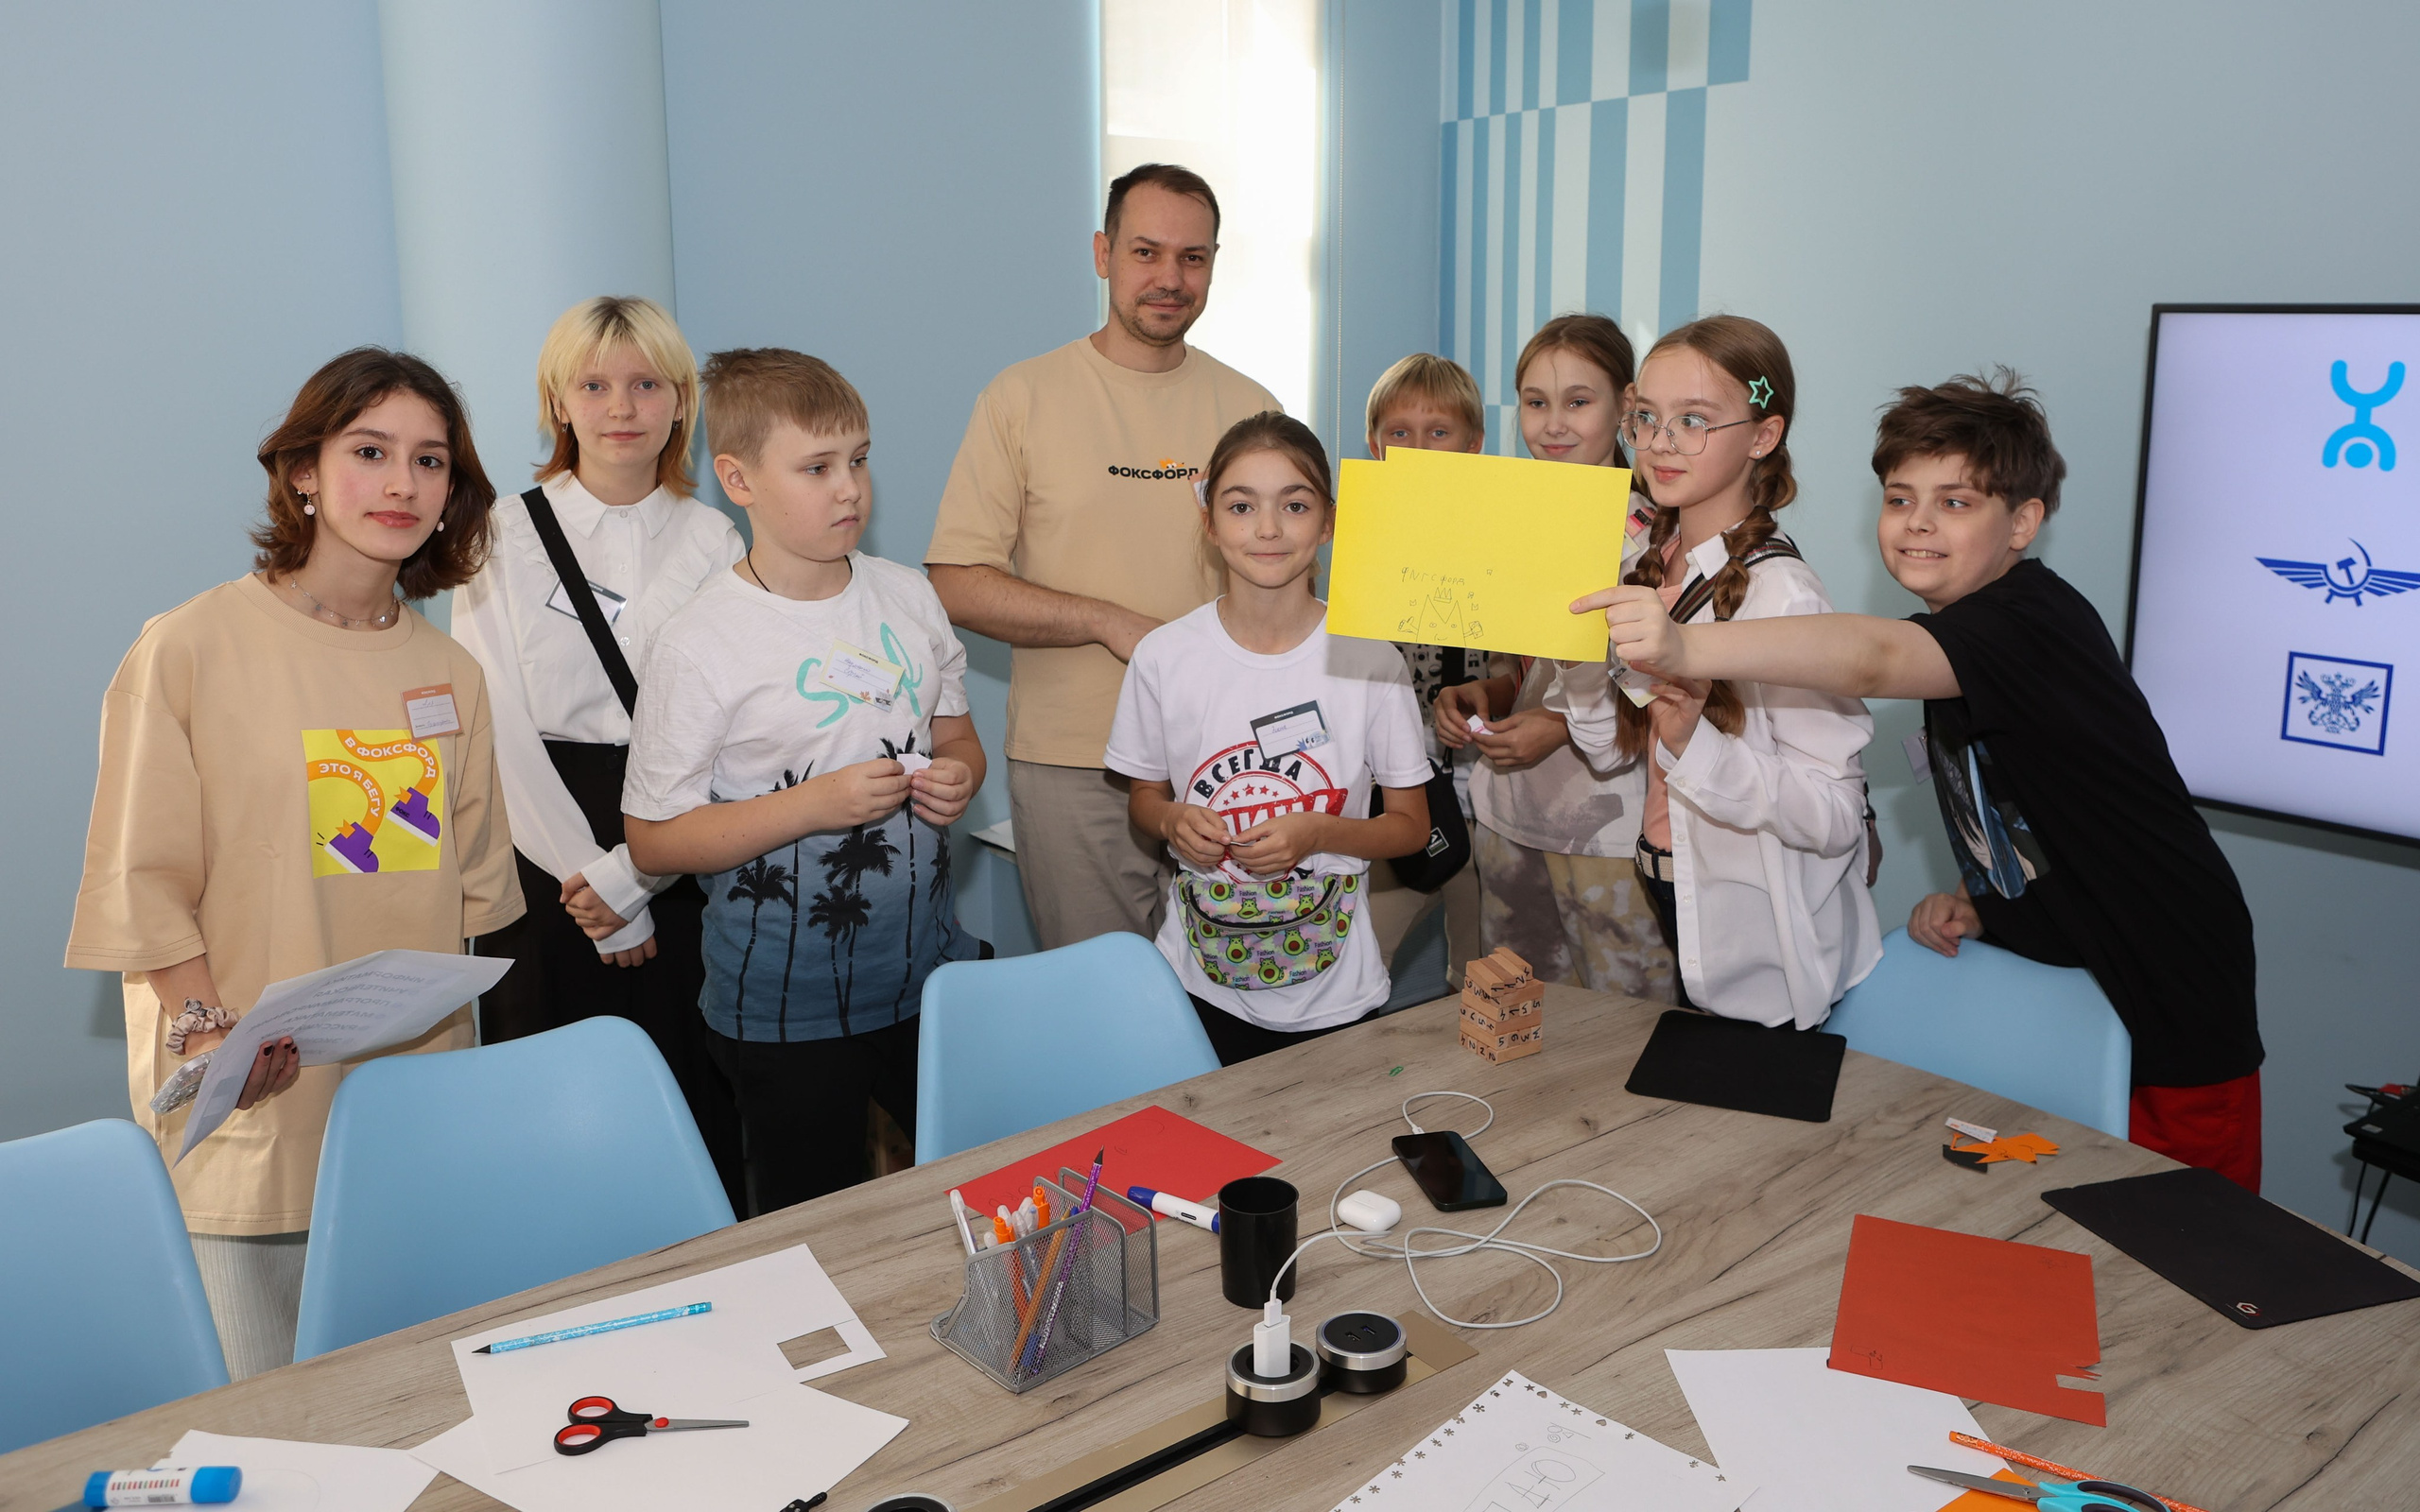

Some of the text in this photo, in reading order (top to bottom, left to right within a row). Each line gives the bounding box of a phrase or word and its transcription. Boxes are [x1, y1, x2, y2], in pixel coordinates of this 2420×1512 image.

[345, 736, 437, 779] В ФОКСФОРД
[319, 763, 381, 816] ЭТО Я БЕГУ
